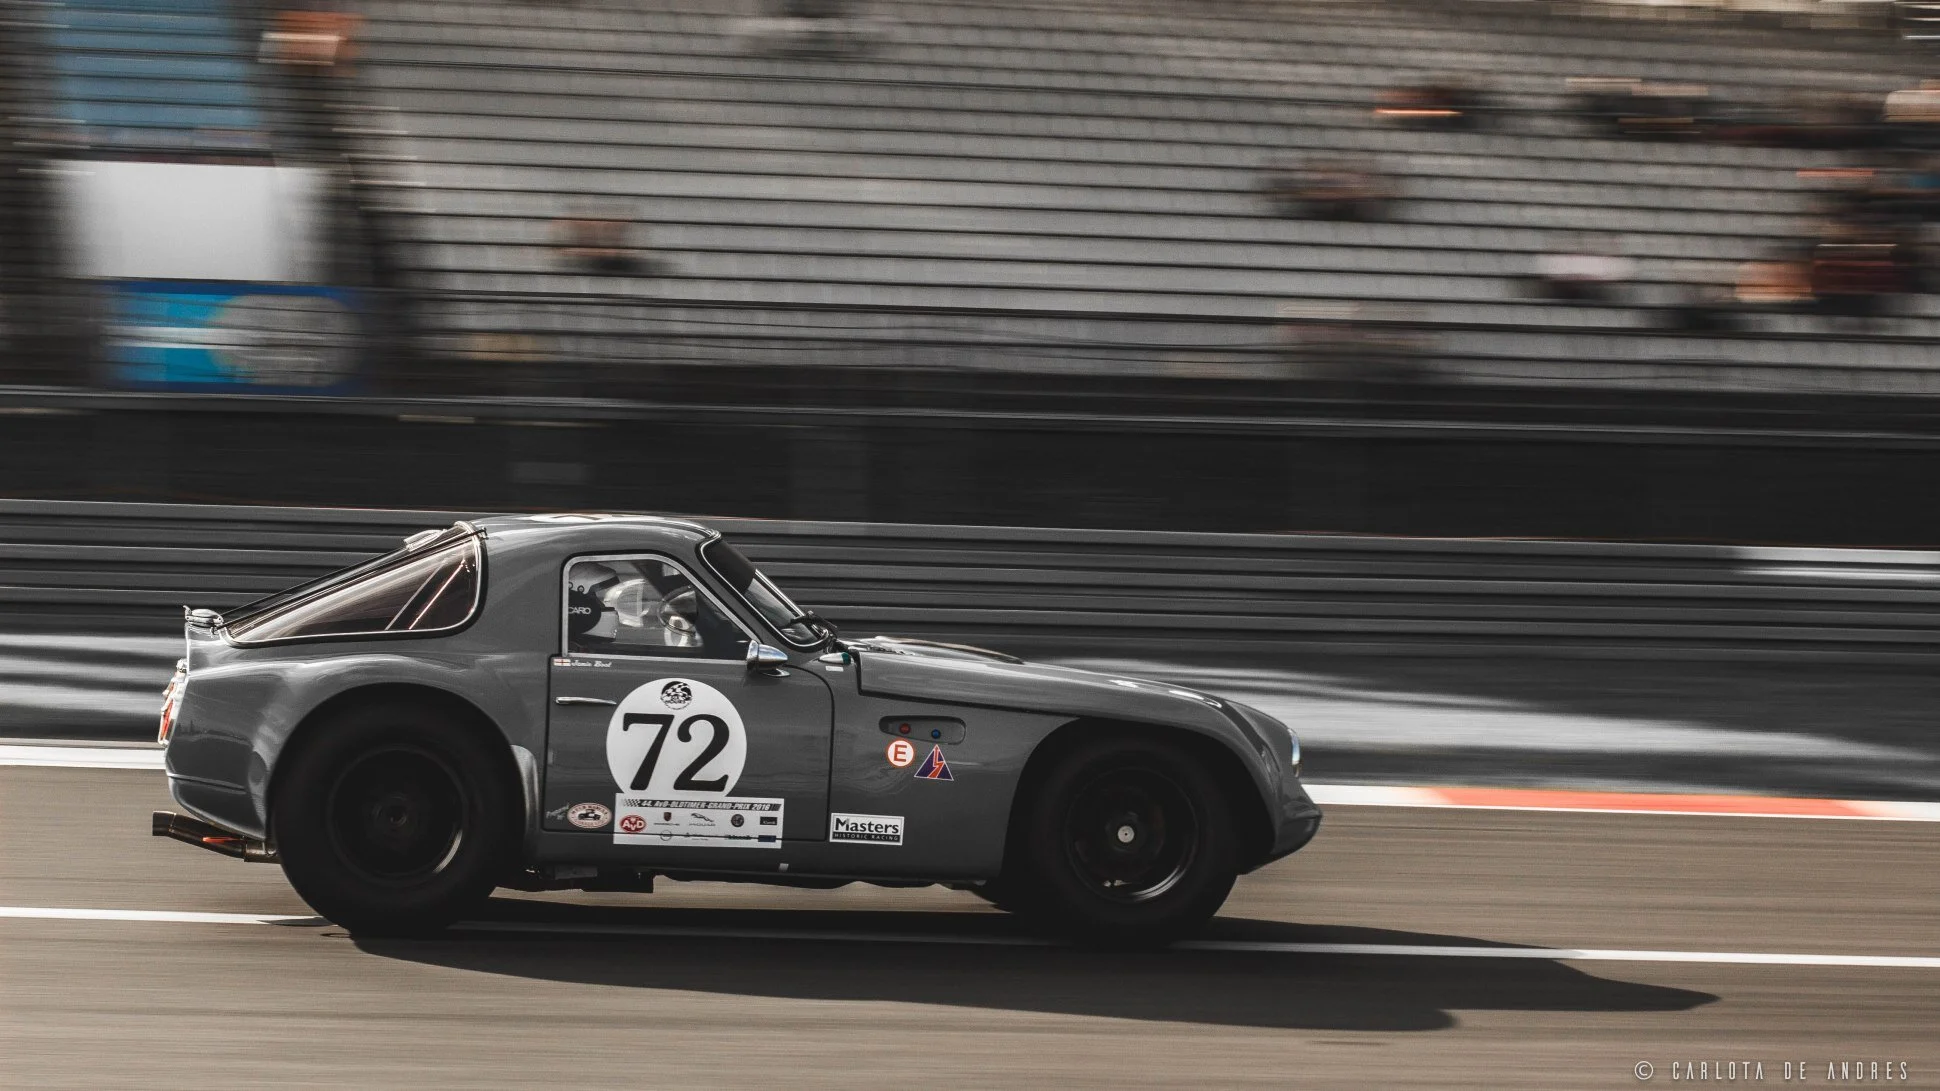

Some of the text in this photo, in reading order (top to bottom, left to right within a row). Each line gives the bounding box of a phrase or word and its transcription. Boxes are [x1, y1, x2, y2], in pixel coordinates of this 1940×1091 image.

[623, 713, 730, 792] 72
[894, 744, 907, 762] E
[641, 800, 652, 808] 44.
[752, 803, 771, 811] 2016
[622, 819, 645, 831] AvD
[835, 817, 899, 834] Masters
[834, 832, 867, 840] HISTORIC
